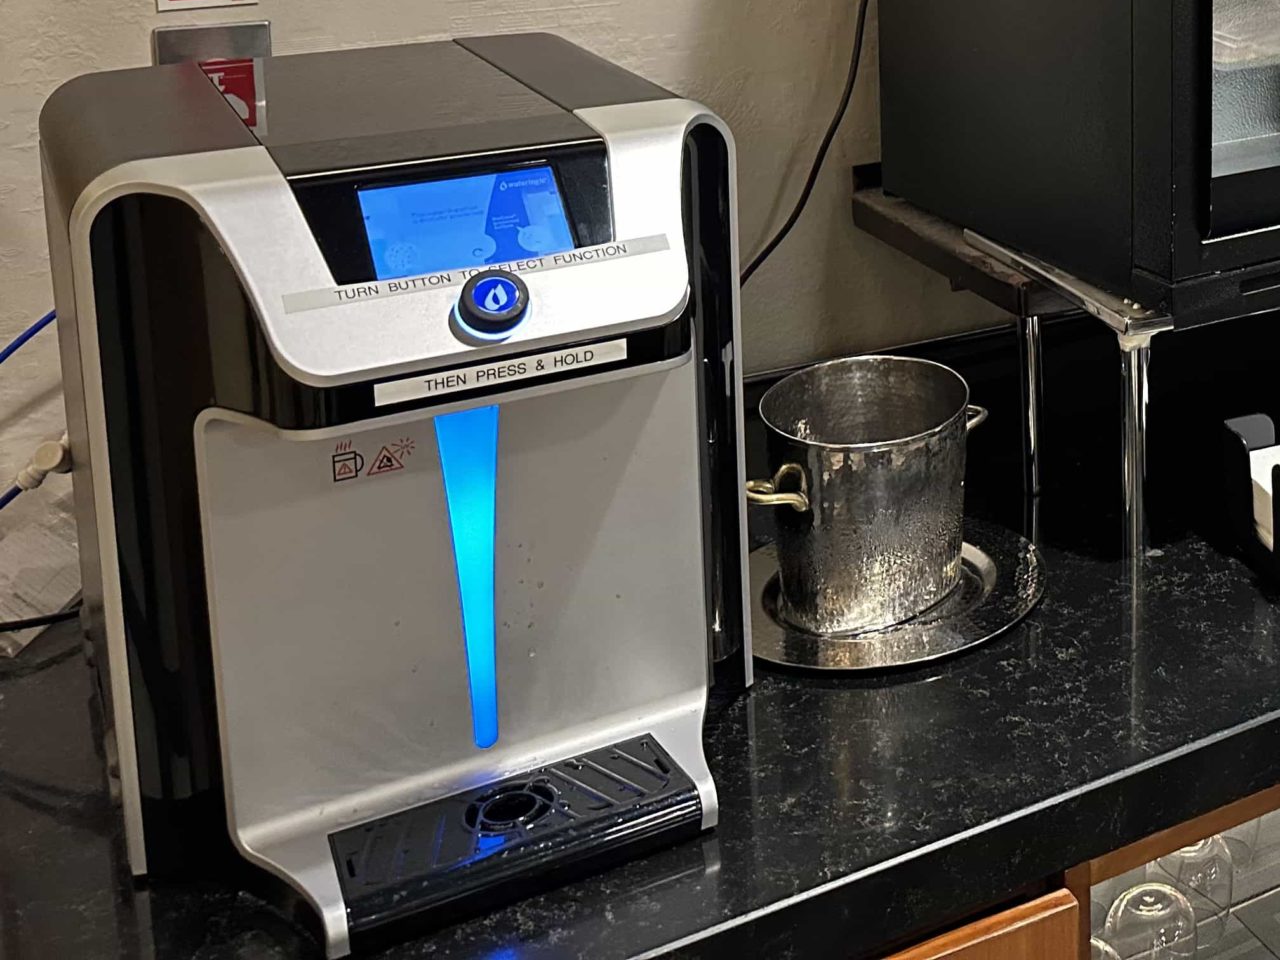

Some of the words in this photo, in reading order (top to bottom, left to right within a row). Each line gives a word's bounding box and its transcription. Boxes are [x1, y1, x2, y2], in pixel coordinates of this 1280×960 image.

[334, 285, 380, 301] TURN
[388, 272, 452, 293] BUTTON
[553, 243, 628, 266] FUNCTION
[424, 374, 468, 393] THEN
[475, 363, 528, 383] PRESS
[534, 358, 546, 372] &
[553, 349, 595, 369] HOLD
